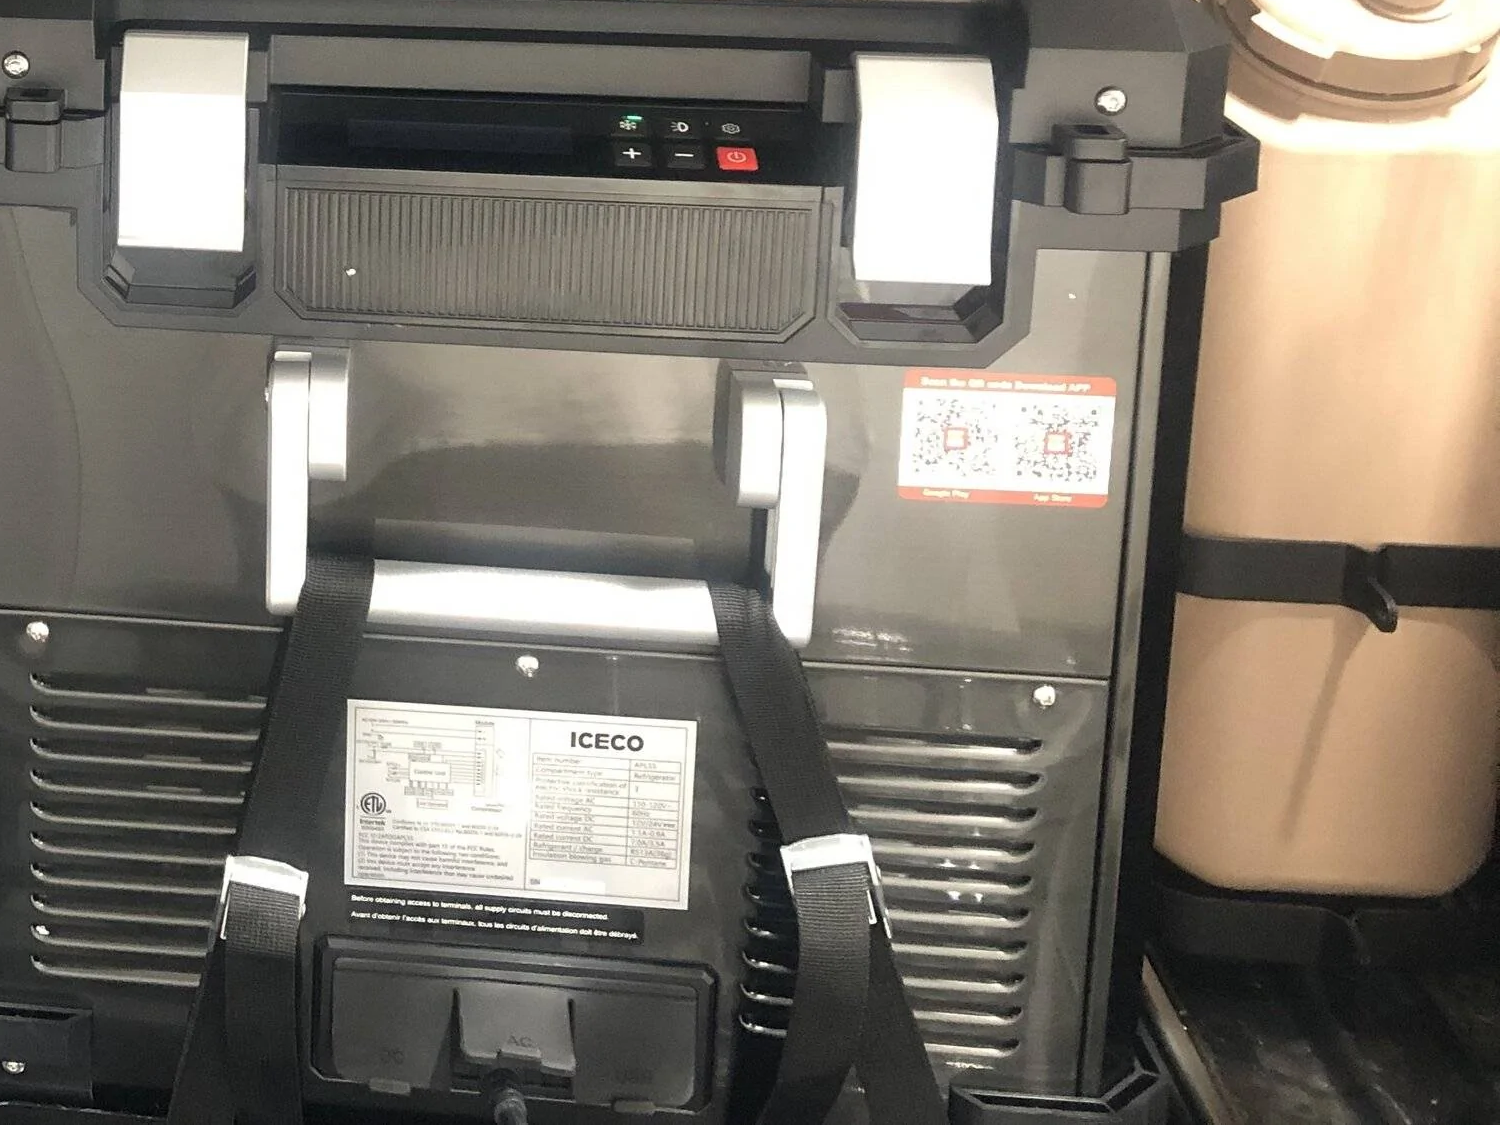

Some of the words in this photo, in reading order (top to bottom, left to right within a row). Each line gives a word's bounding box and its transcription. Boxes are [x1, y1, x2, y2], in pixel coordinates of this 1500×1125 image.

[570, 731, 644, 752] ICECO
[351, 894, 373, 902] Before
[375, 896, 405, 906] obtaining
[407, 898, 430, 906] access
[484, 904, 506, 913] supply
[508, 906, 531, 914] circuits
[350, 910, 369, 918] Avant
[505, 922, 529, 930] circuits
